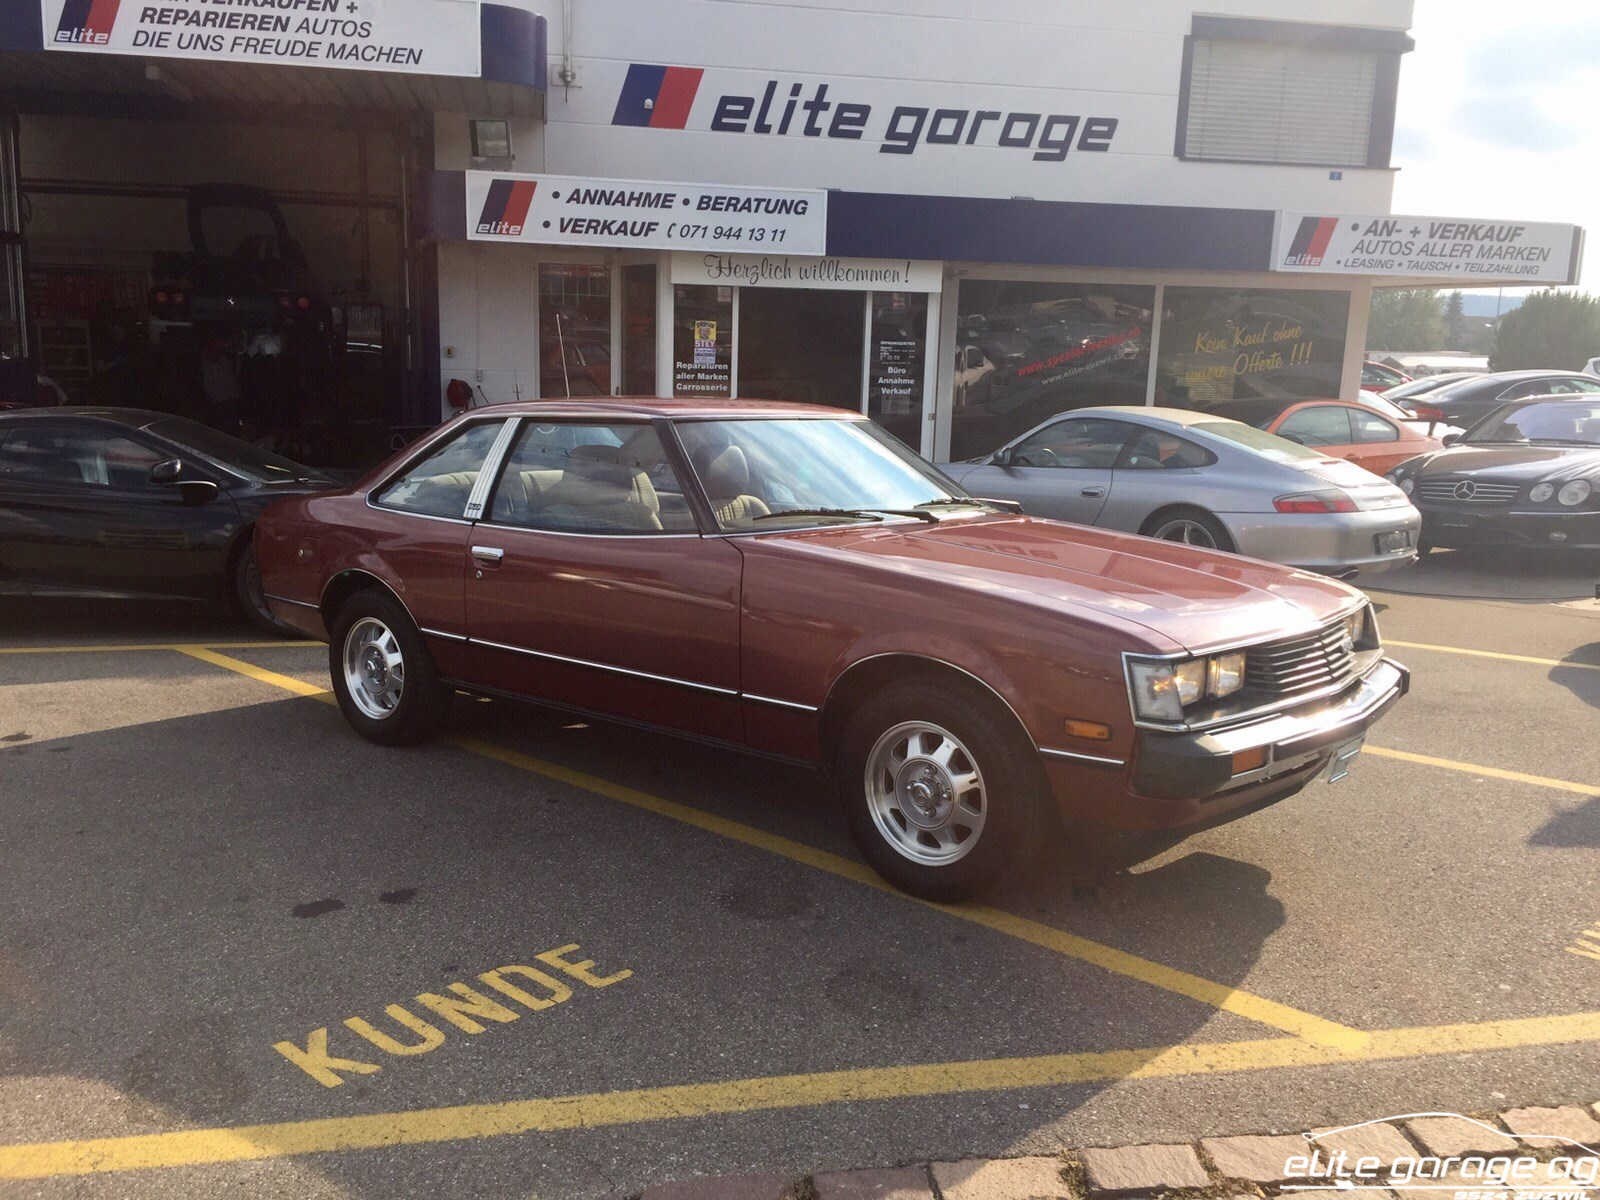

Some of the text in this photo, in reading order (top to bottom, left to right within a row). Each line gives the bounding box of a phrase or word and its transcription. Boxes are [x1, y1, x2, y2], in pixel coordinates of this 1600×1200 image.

[139, 7, 373, 38] REPARIEREN AUTOS
[56, 27, 108, 44] elite
[132, 30, 423, 64] DIE UNS FREUDE MACHEN
[710, 80, 1118, 161] elite garage
[566, 188, 809, 216] ANNAHME BERATUNG
[477, 220, 521, 235] elite
[560, 217, 787, 242] VERKAUF 071 944 13 11
[1363, 219, 1525, 242] AN- + VERKAUF
[1285, 253, 1321, 266] elite
[1351, 239, 1551, 262] AUTOS ALLER MARKEN
[703, 254, 792, 284] Herzlich
[1344, 257, 1540, 275] LEASING TAUSCH TEILZAHLUNG
[1233, 321, 1271, 346] Kauf
[676, 361, 728, 371] Reparaturen
[887, 366, 906, 374] Büro
[1232, 351, 1283, 376] Offerte
[676, 372, 728, 380] aller Marken
[676, 383, 728, 391] Carrosserie
[881, 387, 911, 395] Verkauf
[272, 944, 633, 1088] KUNDE
